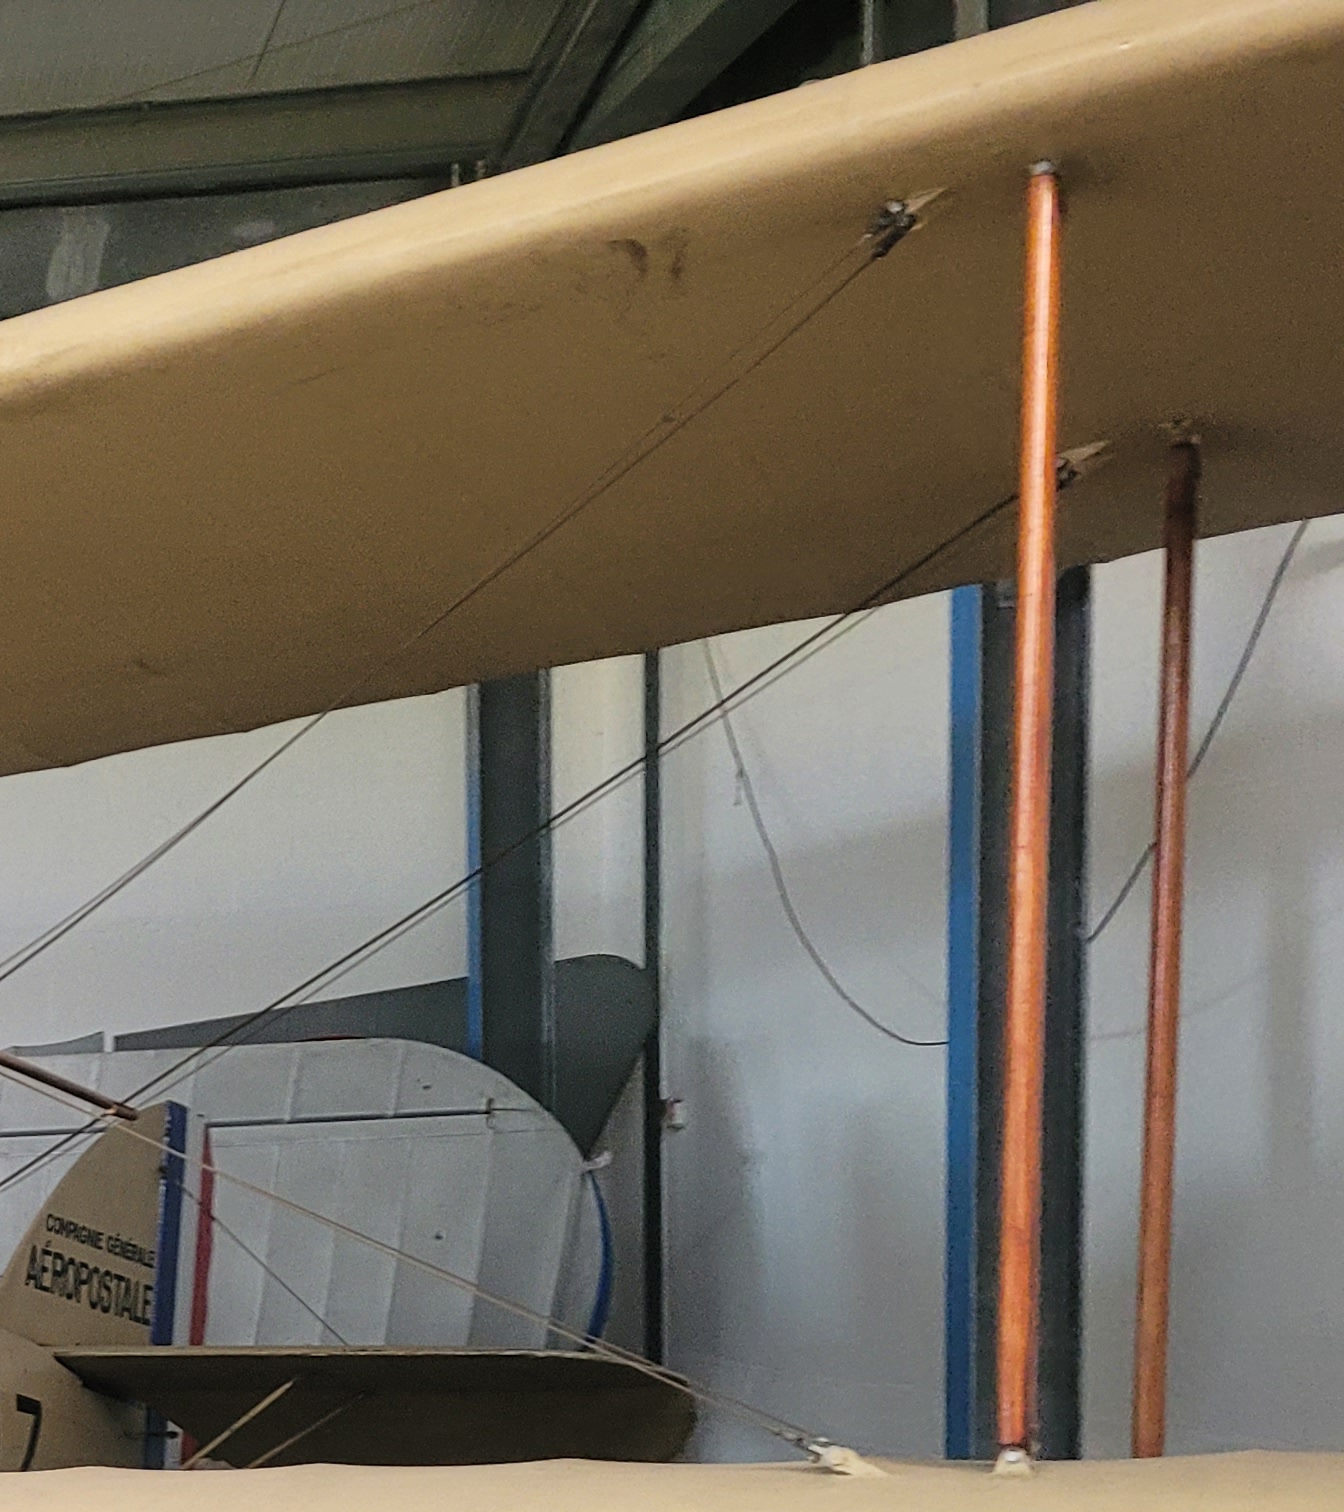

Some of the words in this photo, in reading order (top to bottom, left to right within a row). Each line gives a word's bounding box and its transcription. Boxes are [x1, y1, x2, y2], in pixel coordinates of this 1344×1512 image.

[46, 1213, 105, 1250] COMPAGNIE
[106, 1231, 157, 1269] GÉNÉRALE
[24, 1239, 154, 1327] AÉROPOSTALE
